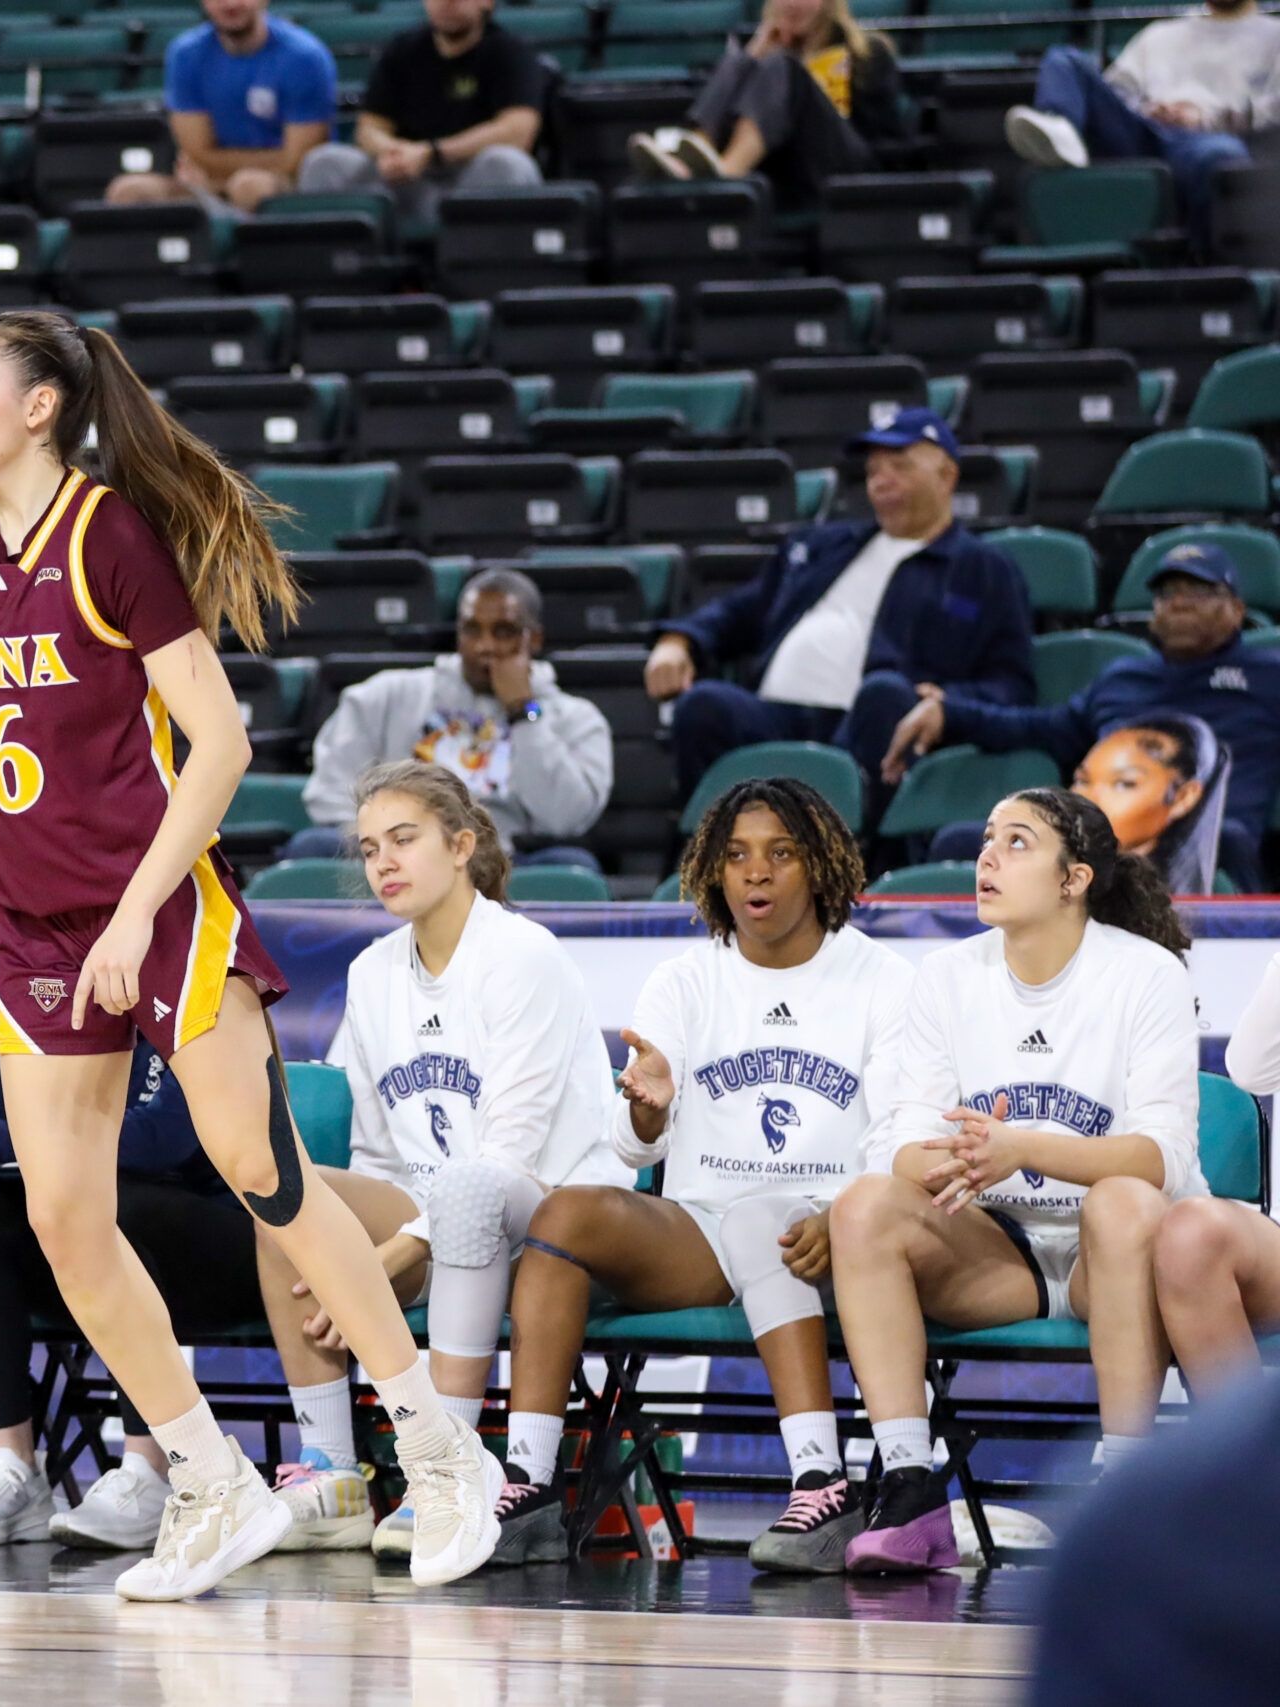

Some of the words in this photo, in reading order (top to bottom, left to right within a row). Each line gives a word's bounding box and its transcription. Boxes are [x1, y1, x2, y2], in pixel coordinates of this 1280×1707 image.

[33, 984, 62, 995] IONA
[762, 1017, 798, 1027] adidas
[417, 1027, 444, 1037] adidas
[1016, 1043, 1054, 1054] adidas
[693, 1046, 860, 1110] TOGETHER
[963, 1082, 1115, 1137] OGETHER
[700, 1154, 763, 1173] PEACOCKS
[764, 1162, 847, 1175] BASKETBALL
[1030, 1196, 1084, 1207] BASKET
